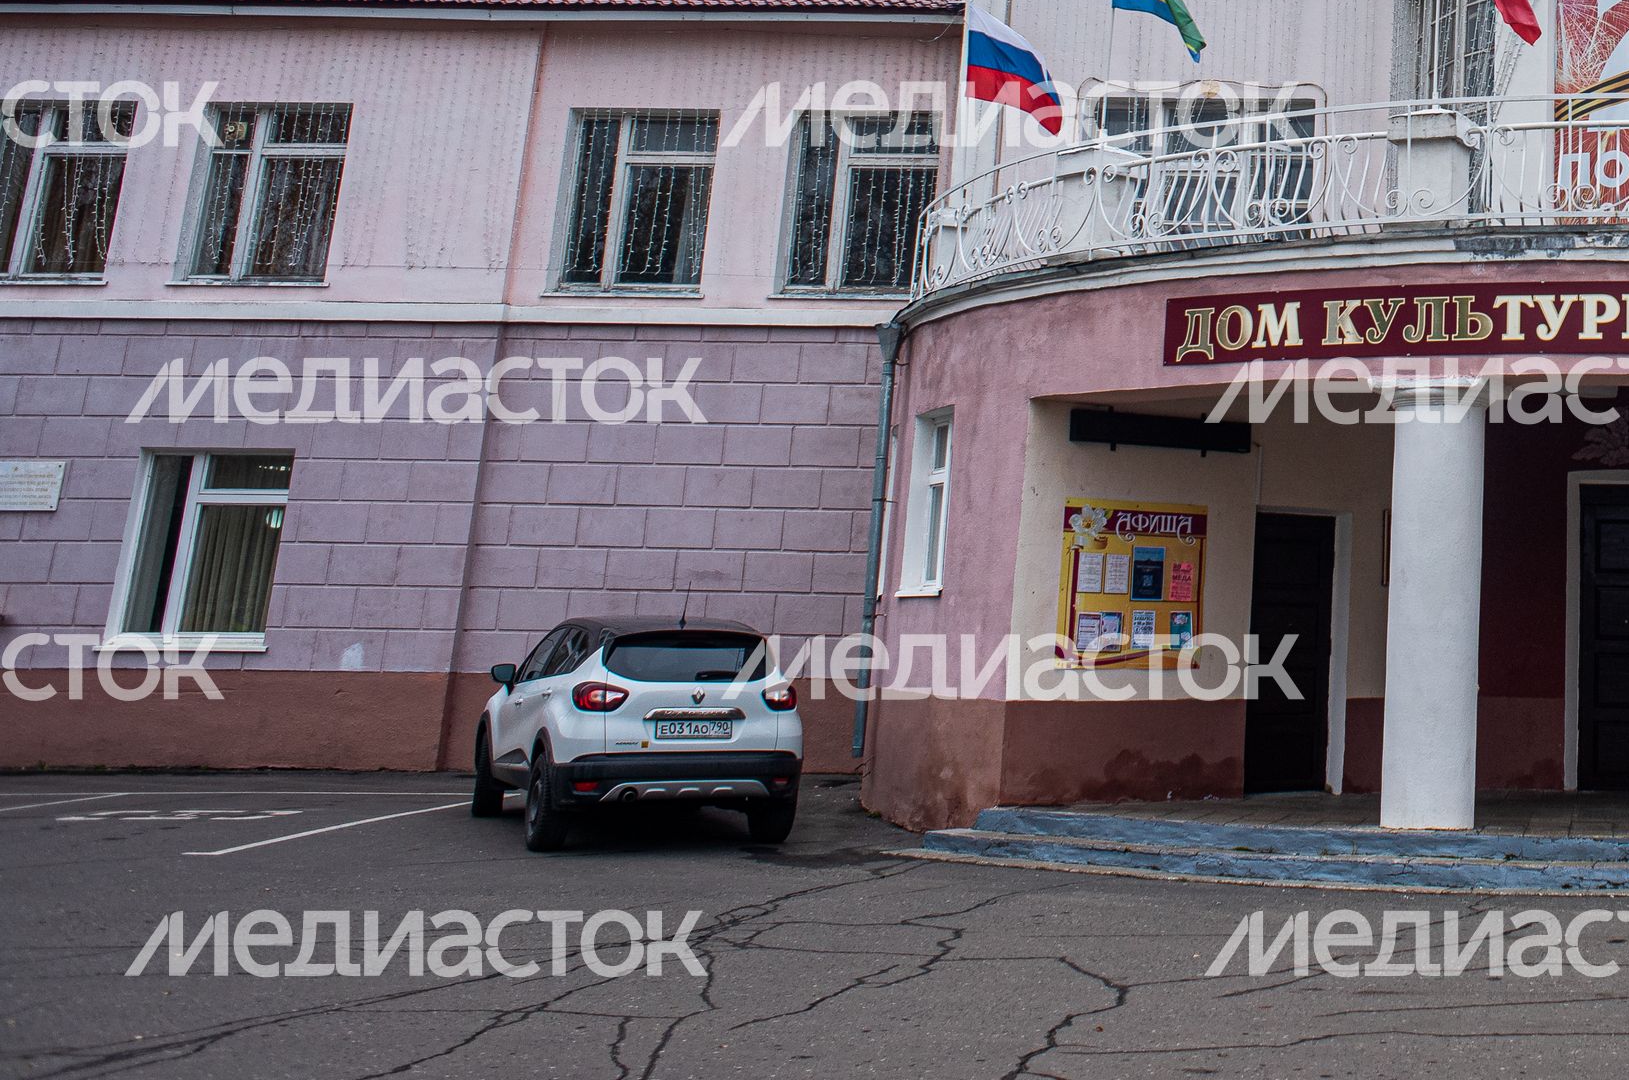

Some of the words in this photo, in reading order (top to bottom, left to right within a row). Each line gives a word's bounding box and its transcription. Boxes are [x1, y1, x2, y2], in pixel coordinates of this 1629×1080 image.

[1176, 301, 1303, 362] ДОМ
[1115, 511, 1196, 547] АФИША
[709, 721, 729, 731] 790
